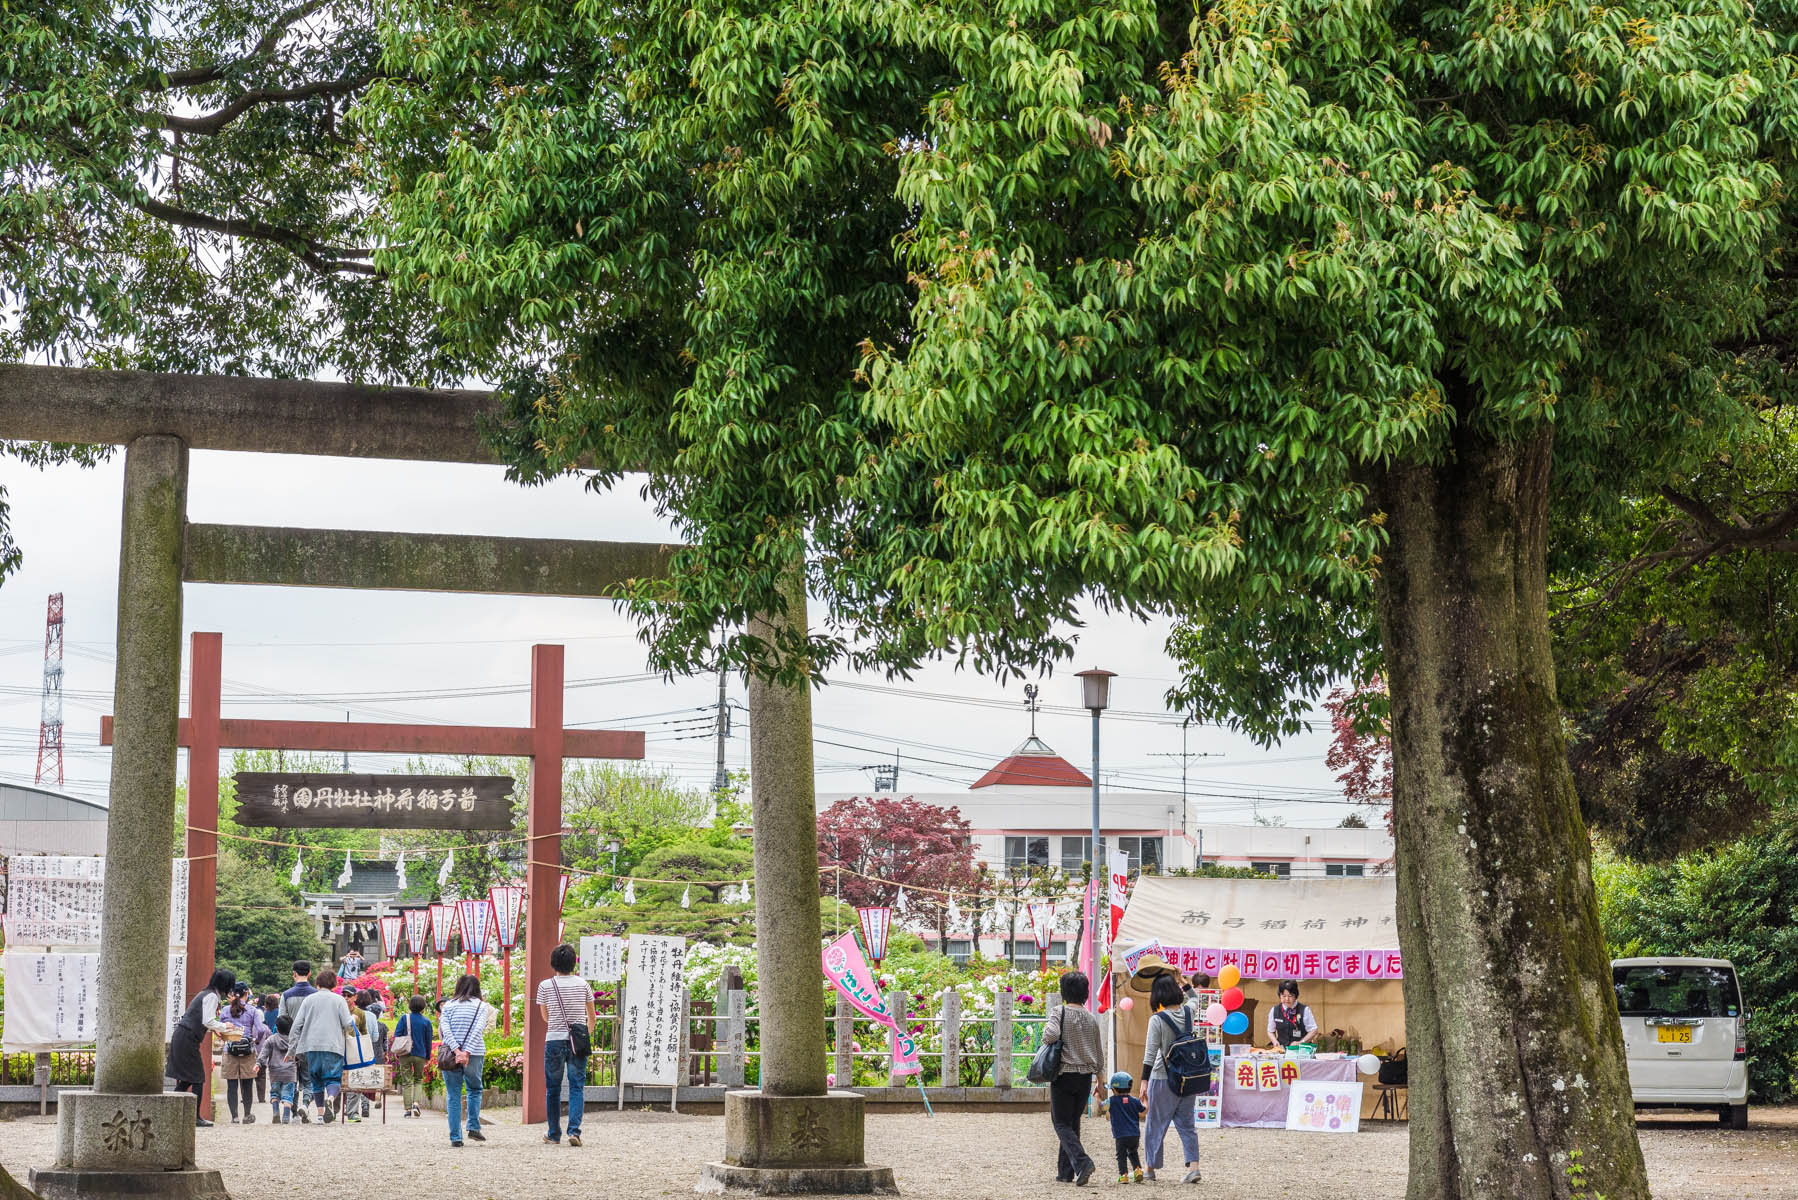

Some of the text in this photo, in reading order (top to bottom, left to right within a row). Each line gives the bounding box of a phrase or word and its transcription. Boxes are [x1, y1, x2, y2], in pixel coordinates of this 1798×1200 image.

[666, 947, 684, 1063] 牡丹維持ご協賛のお願い
[1237, 1063, 1298, 1088] 発売中
[101, 1109, 156, 1151] 納
